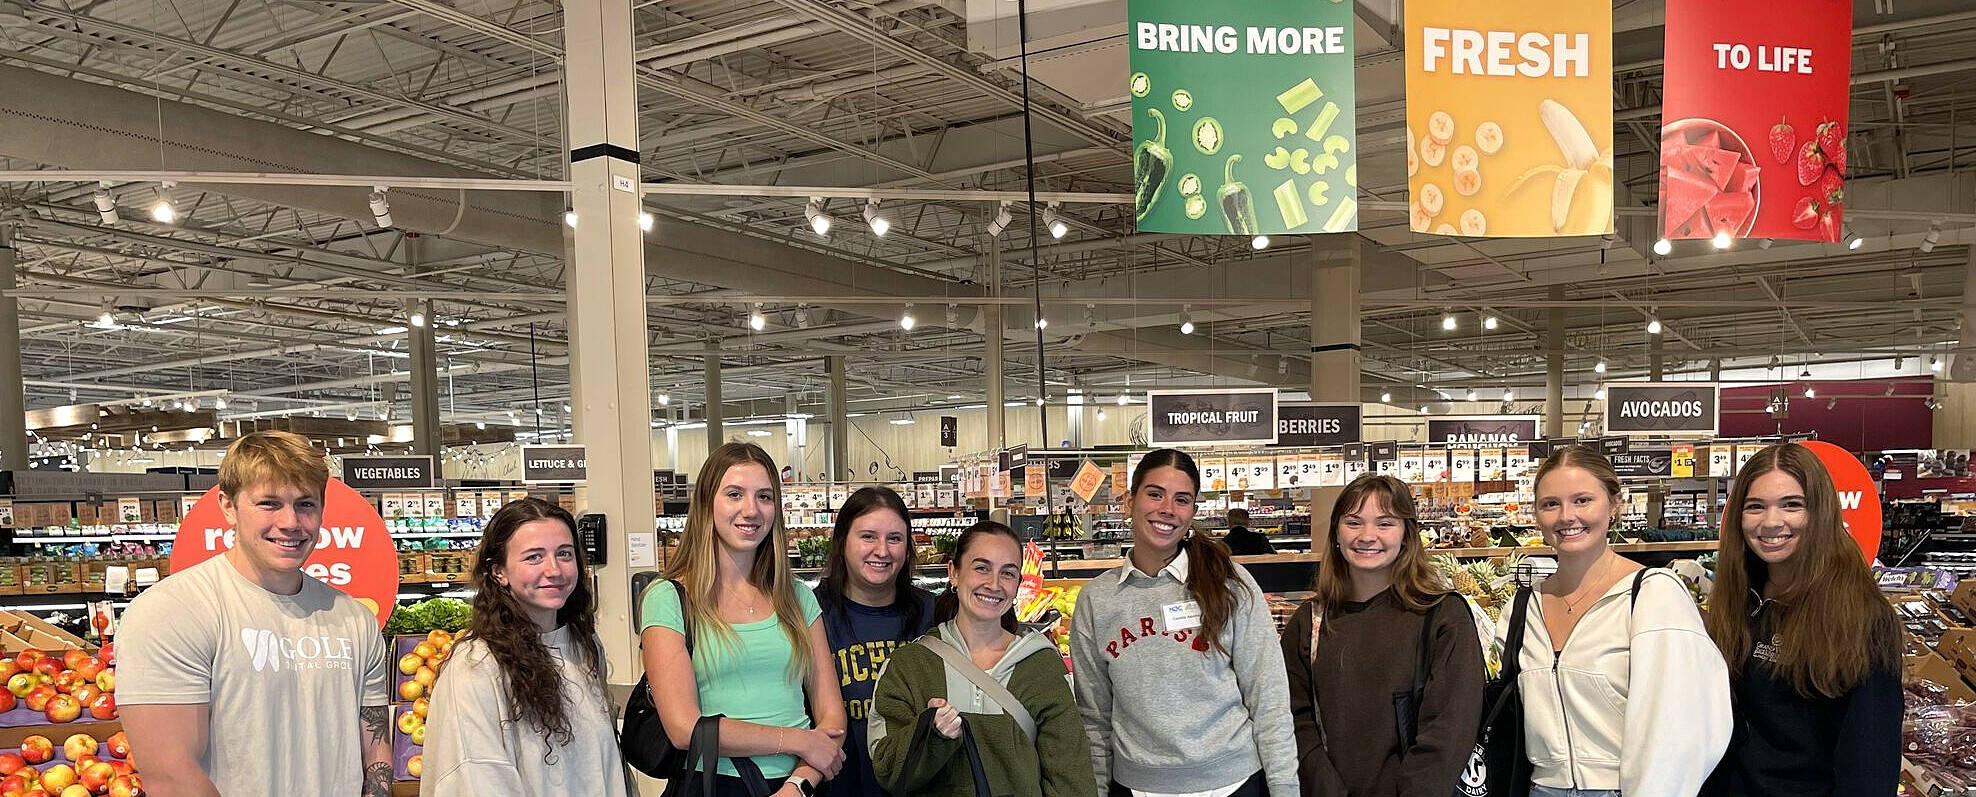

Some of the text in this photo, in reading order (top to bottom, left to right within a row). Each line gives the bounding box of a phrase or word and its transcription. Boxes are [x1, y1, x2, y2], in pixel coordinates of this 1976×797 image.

[1137, 22, 1345, 54] BRING MORE
[1423, 27, 1590, 78] FRESH
[1713, 43, 1813, 75] TO LIFE
[1167, 410, 1259, 425] TROPICAL FRUIT
[1620, 400, 1702, 418] AVOCADOS
[1278, 418, 1341, 434] BERRIES
[1446, 432, 1519, 450] BANANAS
[529, 459, 566, 469] LETTUCE
[568, 460, 575, 468] &
[1614, 454, 1650, 464] FRESH FACTS
[354, 467, 421, 479] VEGETABLES
[1838, 490, 1863, 511] w
[204, 526, 365, 551] re ow
[305, 562, 352, 586] es
[279, 635, 353, 660] GOLE
[1106, 616, 1193, 659] PARS
[832, 639, 907, 687] ICH
[1465, 783, 1488, 796] DAIRY
